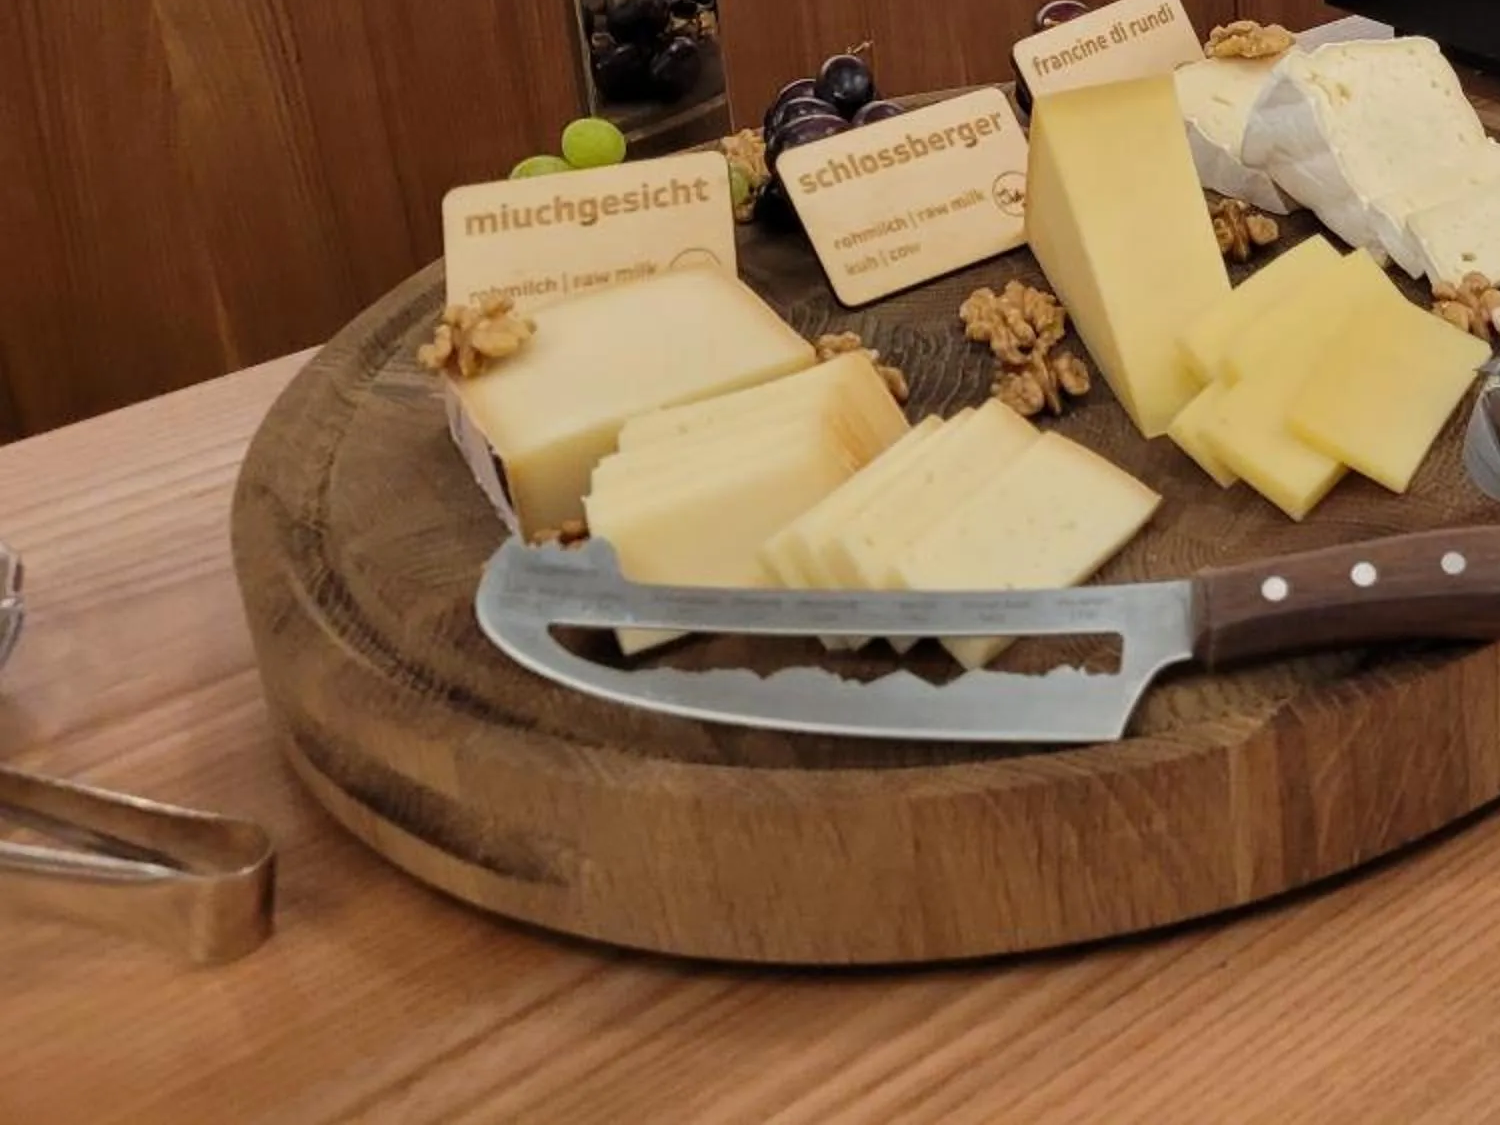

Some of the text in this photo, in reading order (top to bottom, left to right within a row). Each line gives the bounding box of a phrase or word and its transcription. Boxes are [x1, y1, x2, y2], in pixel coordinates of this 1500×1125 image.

[1032, 3, 1175, 76] francine di rundi
[798, 111, 1002, 194] schlossberger
[465, 178, 710, 236] miuchgesicht
[833, 189, 987, 251] rohmilch raw milk
[573, 270, 610, 289] raw
